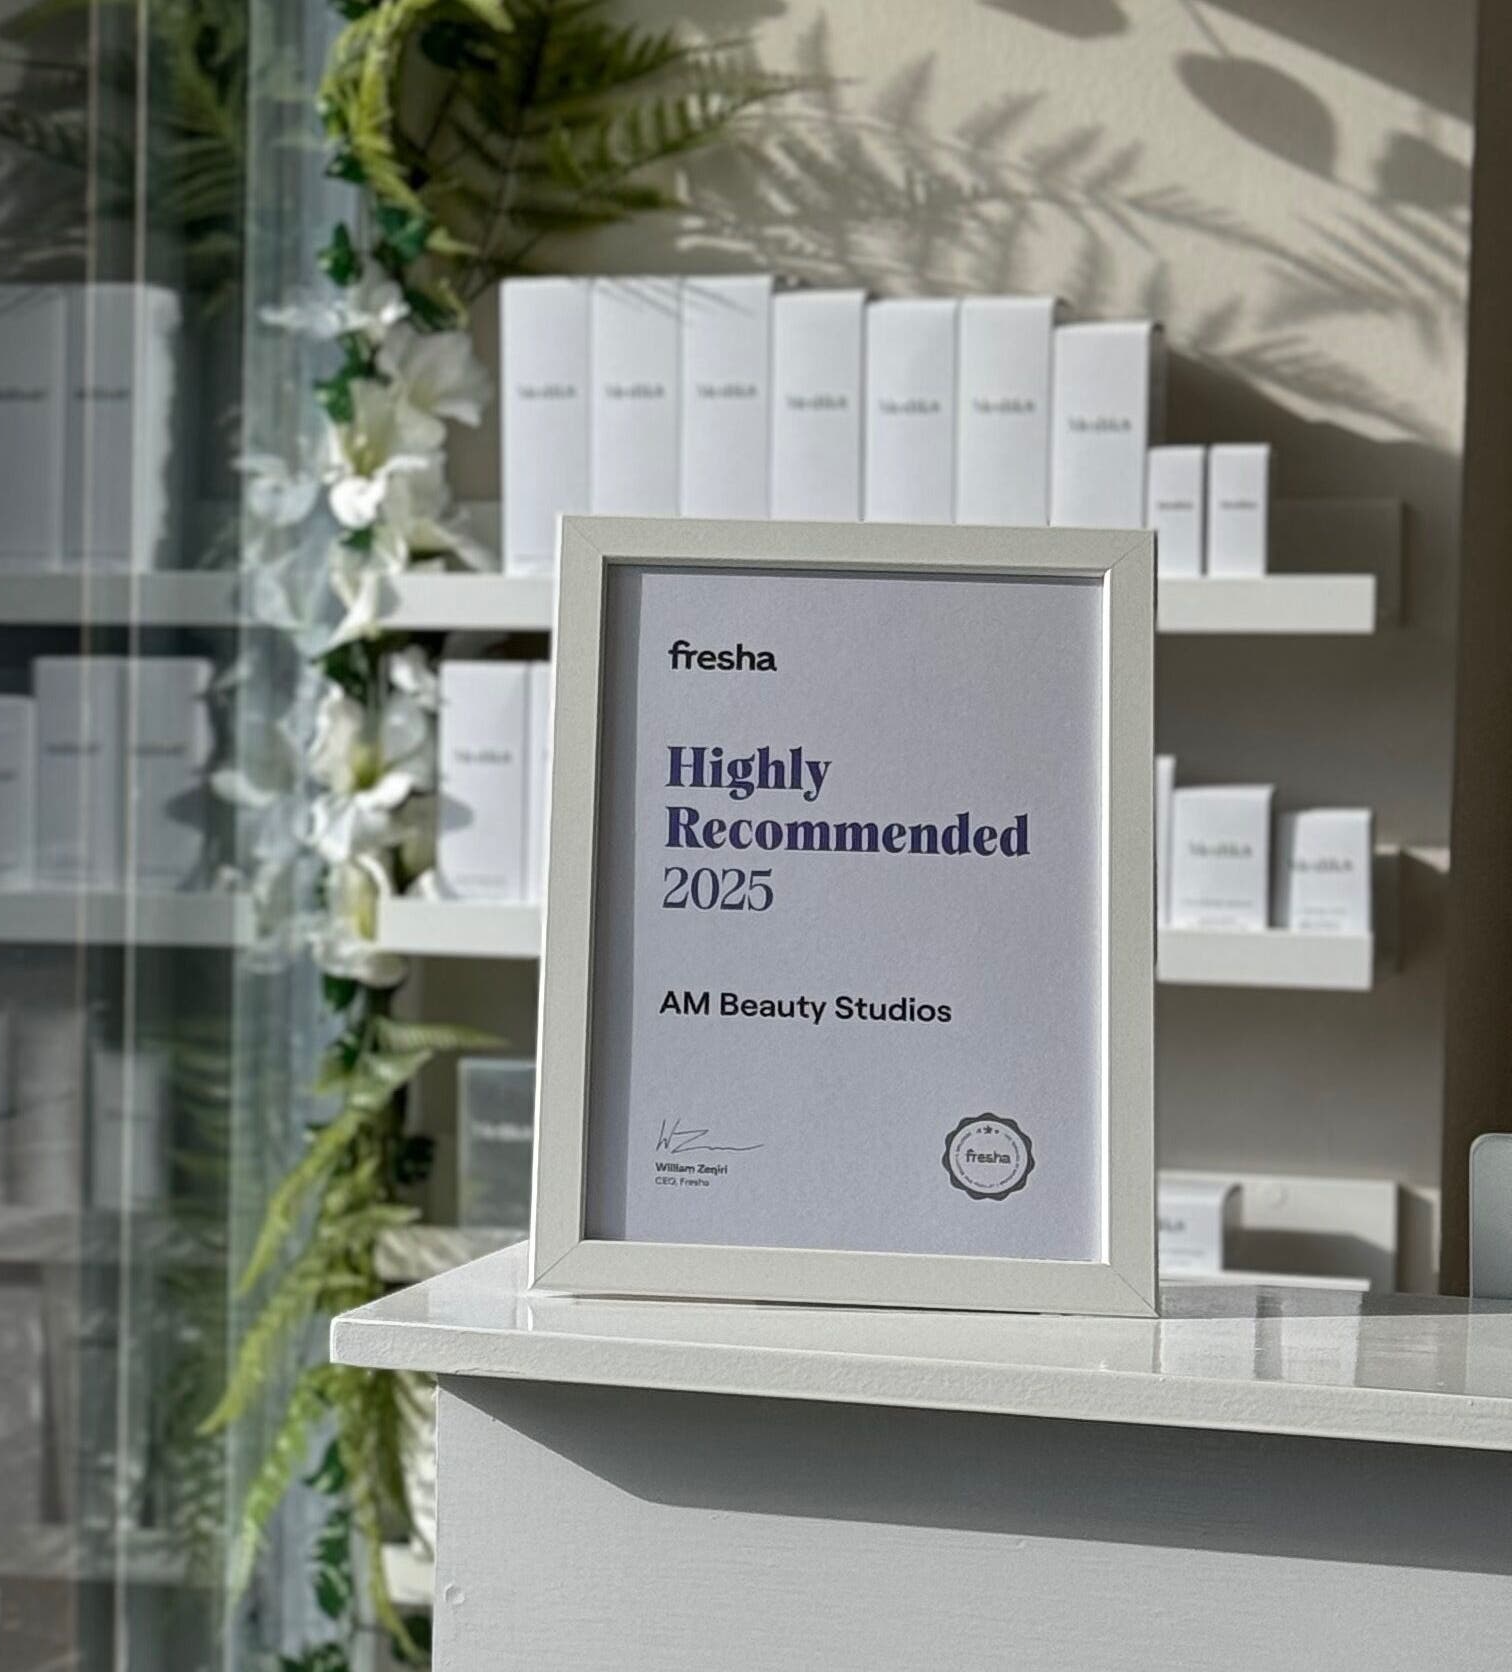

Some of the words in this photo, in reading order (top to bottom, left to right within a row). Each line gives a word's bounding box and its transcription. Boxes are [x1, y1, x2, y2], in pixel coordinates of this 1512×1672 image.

[668, 640, 777, 672] fresha
[665, 746, 832, 802] Highly
[665, 806, 1031, 858] Recommended
[662, 866, 774, 912] 2025
[659, 991, 710, 1016] AM
[719, 993, 827, 1025] Beauty
[834, 996, 952, 1023] Studios
[655, 1162, 695, 1174] William
[965, 1148, 1011, 1164] fresha
